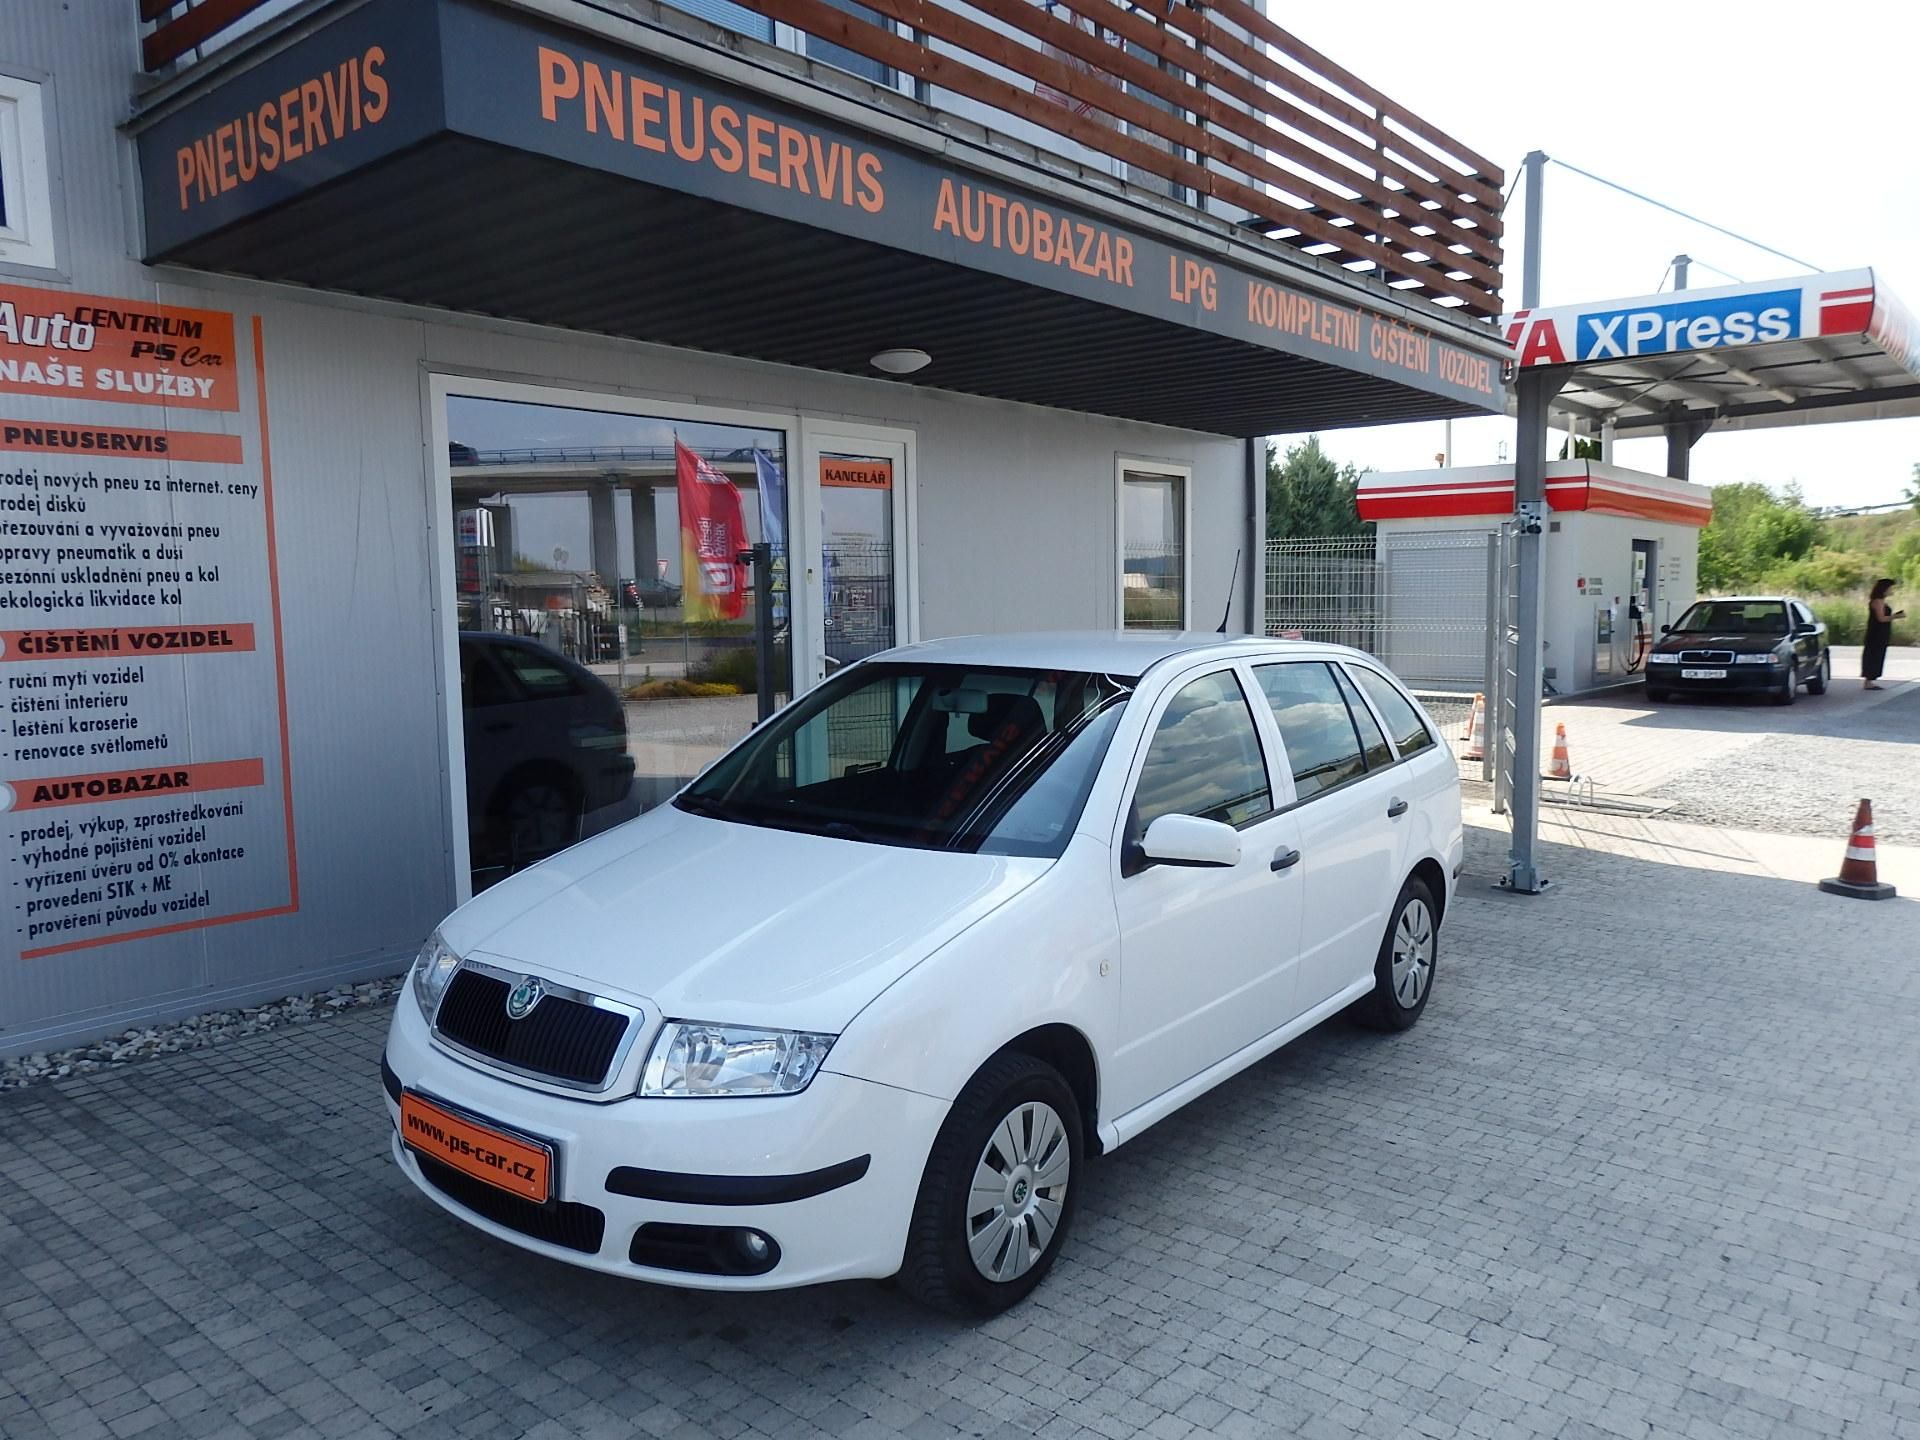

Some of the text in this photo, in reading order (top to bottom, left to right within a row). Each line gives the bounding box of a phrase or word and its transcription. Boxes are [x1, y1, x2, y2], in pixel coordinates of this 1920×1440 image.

[177, 46, 389, 210] PNEUSERVIS
[538, 46, 1493, 394] PNEUSERVIS AUTOBAZAR LPG KOMPLETNÍ ČIŠTĚNÍ VOZIDEL
[0, 300, 203, 352] Auto CENTRUM
[1587, 306, 1792, 360] XPress
[131, 341, 223, 367] PS Car
[0, 356, 215, 399] NAŠE SLUŽBY
[4, 427, 168, 453] PNEUSERVIS
[44, 471, 98, 493] nových
[104, 478, 139, 493] pneu
[144, 480, 161, 491] za
[166, 475, 224, 494] internet.
[228, 484, 258, 499] ceny
[825, 469, 886, 485] KANCELÁŘ
[46, 494, 86, 513] disků
[85, 525, 94, 537] a
[100, 522, 183, 541] vyvažování
[188, 526, 220, 542] pneu
[57, 543, 136, 564] pneumatik
[142, 549, 151, 560] a
[61, 566, 142, 583] uskladnění
[147, 571, 180, 587] pneu
[185, 571, 193, 582] a
[198, 565, 219, 582] kol
[0, 588, 182, 612] ekologická likvidace kol
[18, 629, 233, 654] ČIŠTĚNÍ VOZIDEL
[9, 666, 144, 690] ruční mytí vozidel
[11, 695, 60, 713] čištění
[65, 692, 128, 710] interiéru
[13, 719, 64, 737] leštění
[69, 713, 138, 733] karoserie
[15, 745, 85, 761] renovace
[91, 734, 168, 754] světlometů
[32, 771, 190, 802] AUTOBAZAR
[21, 820, 73, 846] prodej,
[79, 816, 128, 838] výkup,
[134, 801, 243, 831] zprostředkování
[23, 843, 89, 869] výhodné
[95, 835, 153, 860] pojištění
[158, 825, 206, 847] vozidel
[25, 865, 86, 892] vyřízení
[92, 862, 132, 879] úvěru
[137, 854, 153, 872] od
[159, 851, 179, 869] 0%
[183, 847, 244, 865] akontace
[27, 886, 102, 917] provedení
[107, 880, 135, 899] STK
[153, 874, 172, 892] ME
[29, 908, 101, 940] prověření
[106, 900, 157, 926] původu
[162, 890, 210, 912] vozidel
[407, 1113, 536, 1182] www.ps-car.cz
